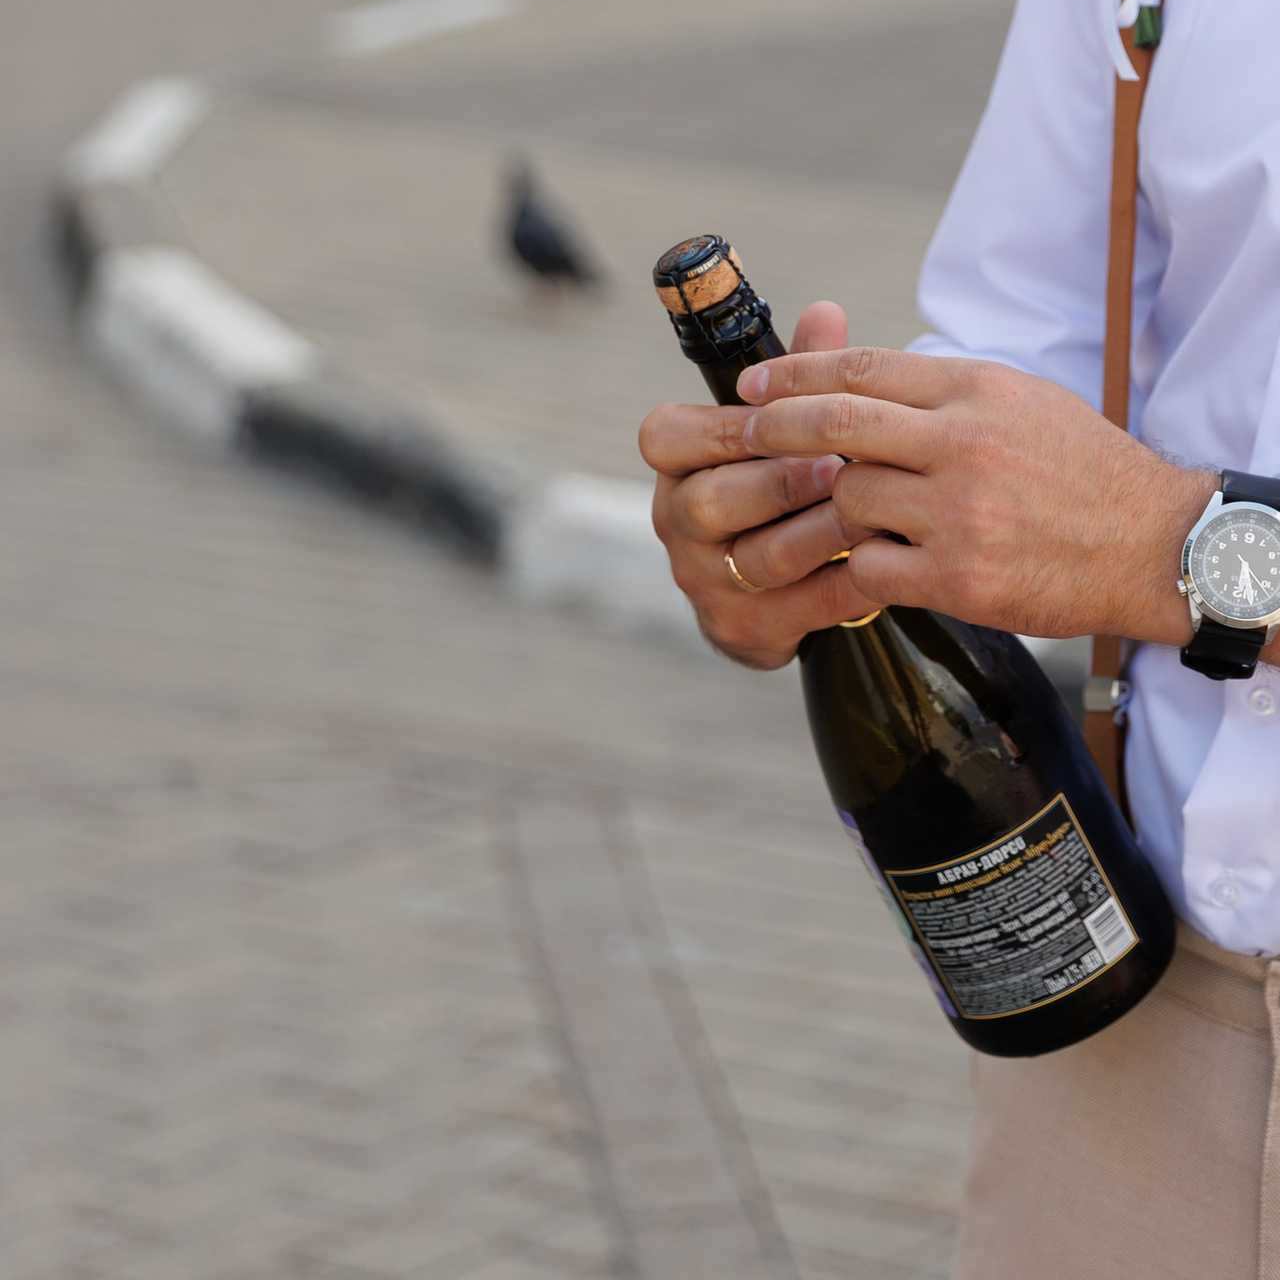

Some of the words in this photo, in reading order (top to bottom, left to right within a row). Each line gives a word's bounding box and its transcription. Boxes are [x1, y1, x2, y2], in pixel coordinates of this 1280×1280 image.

[1230, 533, 1238, 542] 5
[1244, 532, 1256, 544] 6
[1219, 541, 1227, 550] 4
[1259, 539, 1267, 547] 7
[1211, 555, 1220, 564] 3
[1268, 551, 1276, 560] 8
[1213, 570, 1221, 579] 2
[1270, 567, 1278, 575] 9
[1223, 583, 1228, 591] 1
[1261, 580, 1271, 589] 10
